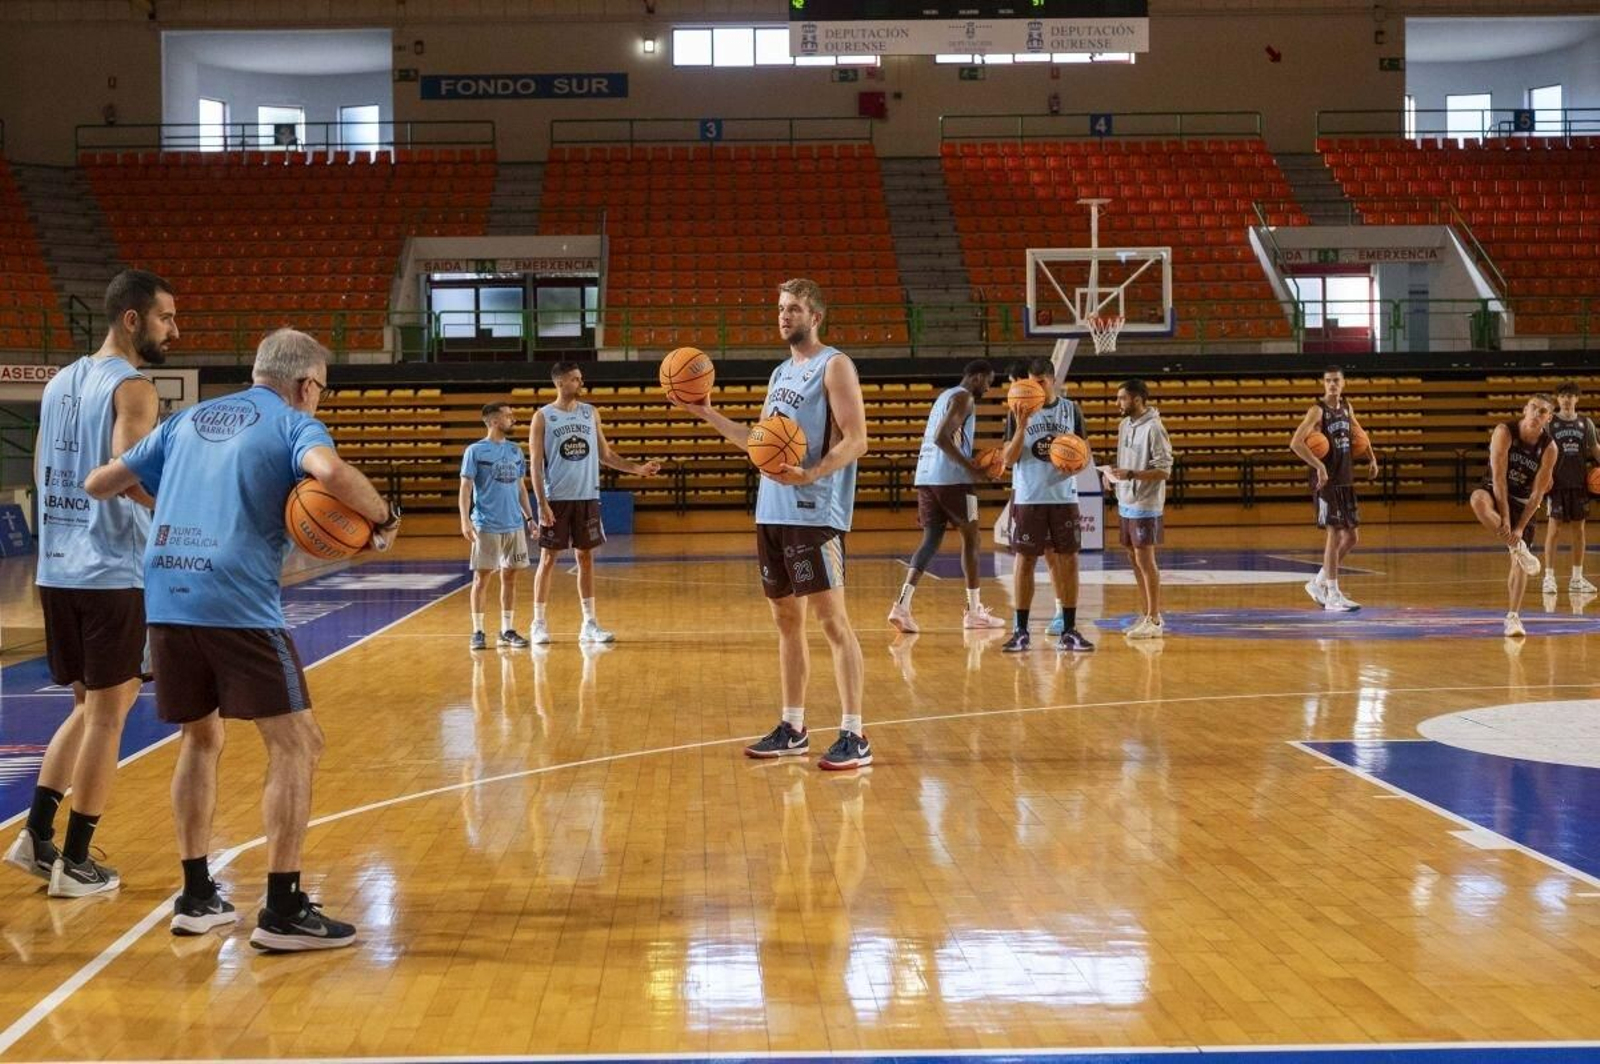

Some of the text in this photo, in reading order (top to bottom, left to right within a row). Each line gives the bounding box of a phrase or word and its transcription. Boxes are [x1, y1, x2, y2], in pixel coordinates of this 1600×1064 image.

[824, 26, 910, 40] DEPUTACIÓN
[1050, 23, 1136, 37] DEPUTACIÓN
[824, 41, 887, 52] OURENSE
[1050, 39, 1112, 50] OURENSE
[440, 77, 609, 96] FONDO SUR
[1095, 116, 1107, 133] 4
[1520, 112, 1531, 129] 5
[705, 121, 717, 138] 3
[1357, 249, 1438, 261] EMERXENCIA
[514, 259, 595, 271] EMERXENCIA
[1, 367, 58, 380] ASEOS
[553, 423, 591, 438] OURENSE
[171, 526, 202, 538] XUNTA
[168, 536, 219, 548] DE GALICIA
[152, 555, 214, 572] ABANCA
[792, 560, 815, 583] 23
